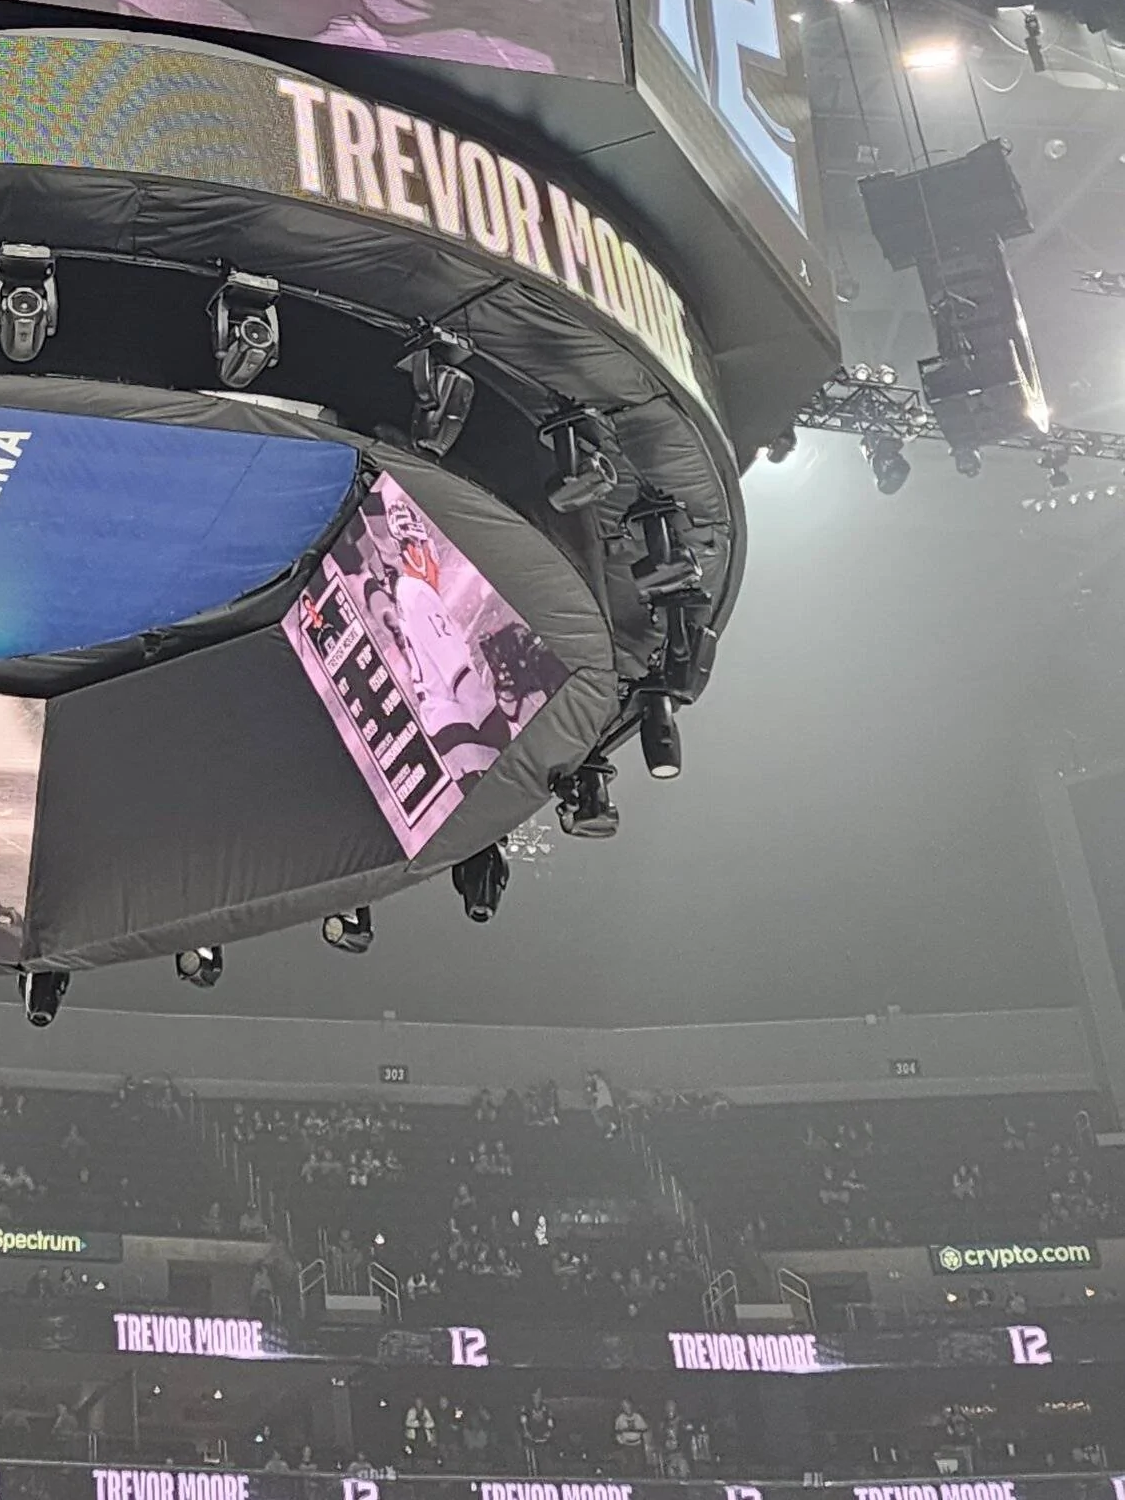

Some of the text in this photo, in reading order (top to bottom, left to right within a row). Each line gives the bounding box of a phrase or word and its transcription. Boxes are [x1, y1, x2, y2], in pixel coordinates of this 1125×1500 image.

[277, 75, 560, 284] TREVOR
[964, 1244, 1091, 1269] crypto.com
[113, 1313, 263, 1356] TREVOR MOORE
[449, 1327, 489, 1367] 12
[668, 1332, 818, 1371] TREVOR MOORE
[1006, 1325, 1053, 1364] 12
[92, 1469, 250, 1500] TREVOR MOORE
